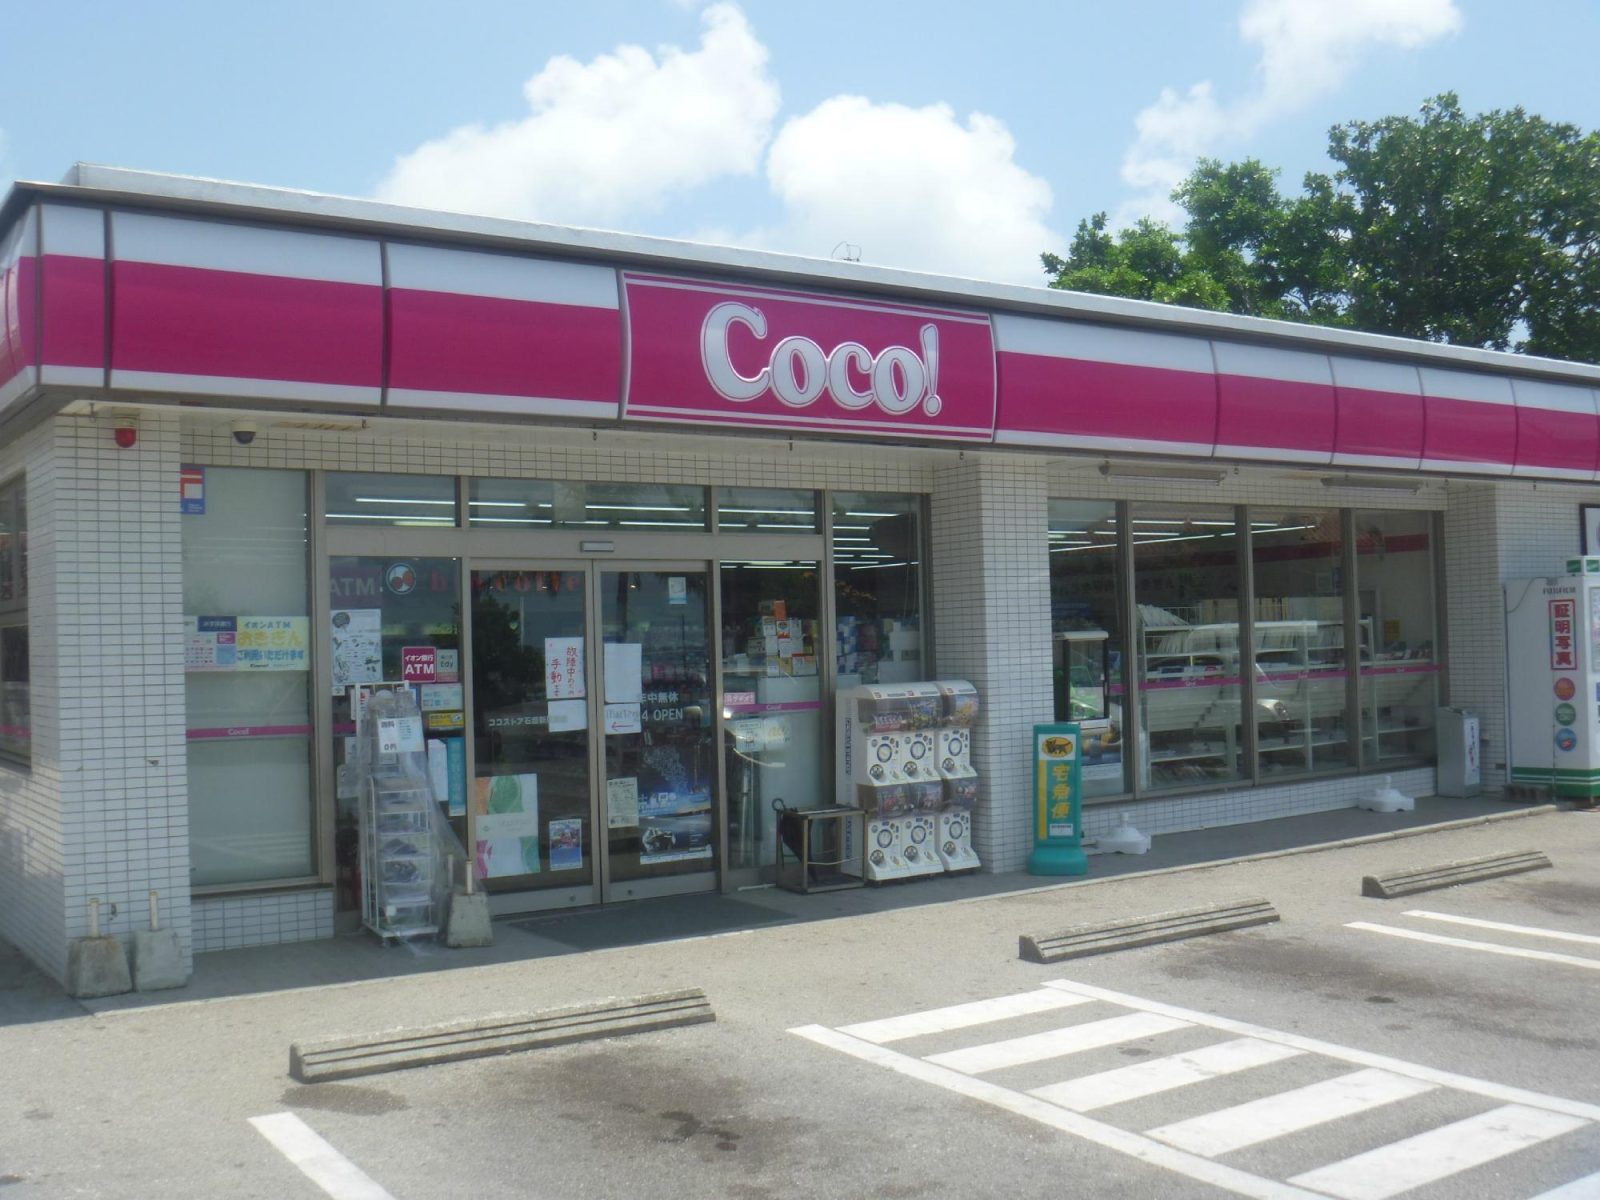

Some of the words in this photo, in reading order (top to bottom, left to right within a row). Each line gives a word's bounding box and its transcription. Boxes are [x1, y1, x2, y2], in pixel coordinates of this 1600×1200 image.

[701, 301, 942, 417] Coco!
[1554, 603, 1572, 665] 証明写真
[404, 654, 434, 662] イオン銀行
[405, 664, 434, 674] ATM
[653, 708, 684, 721] OPEN
[1051, 763, 1072, 820] 宅急便
